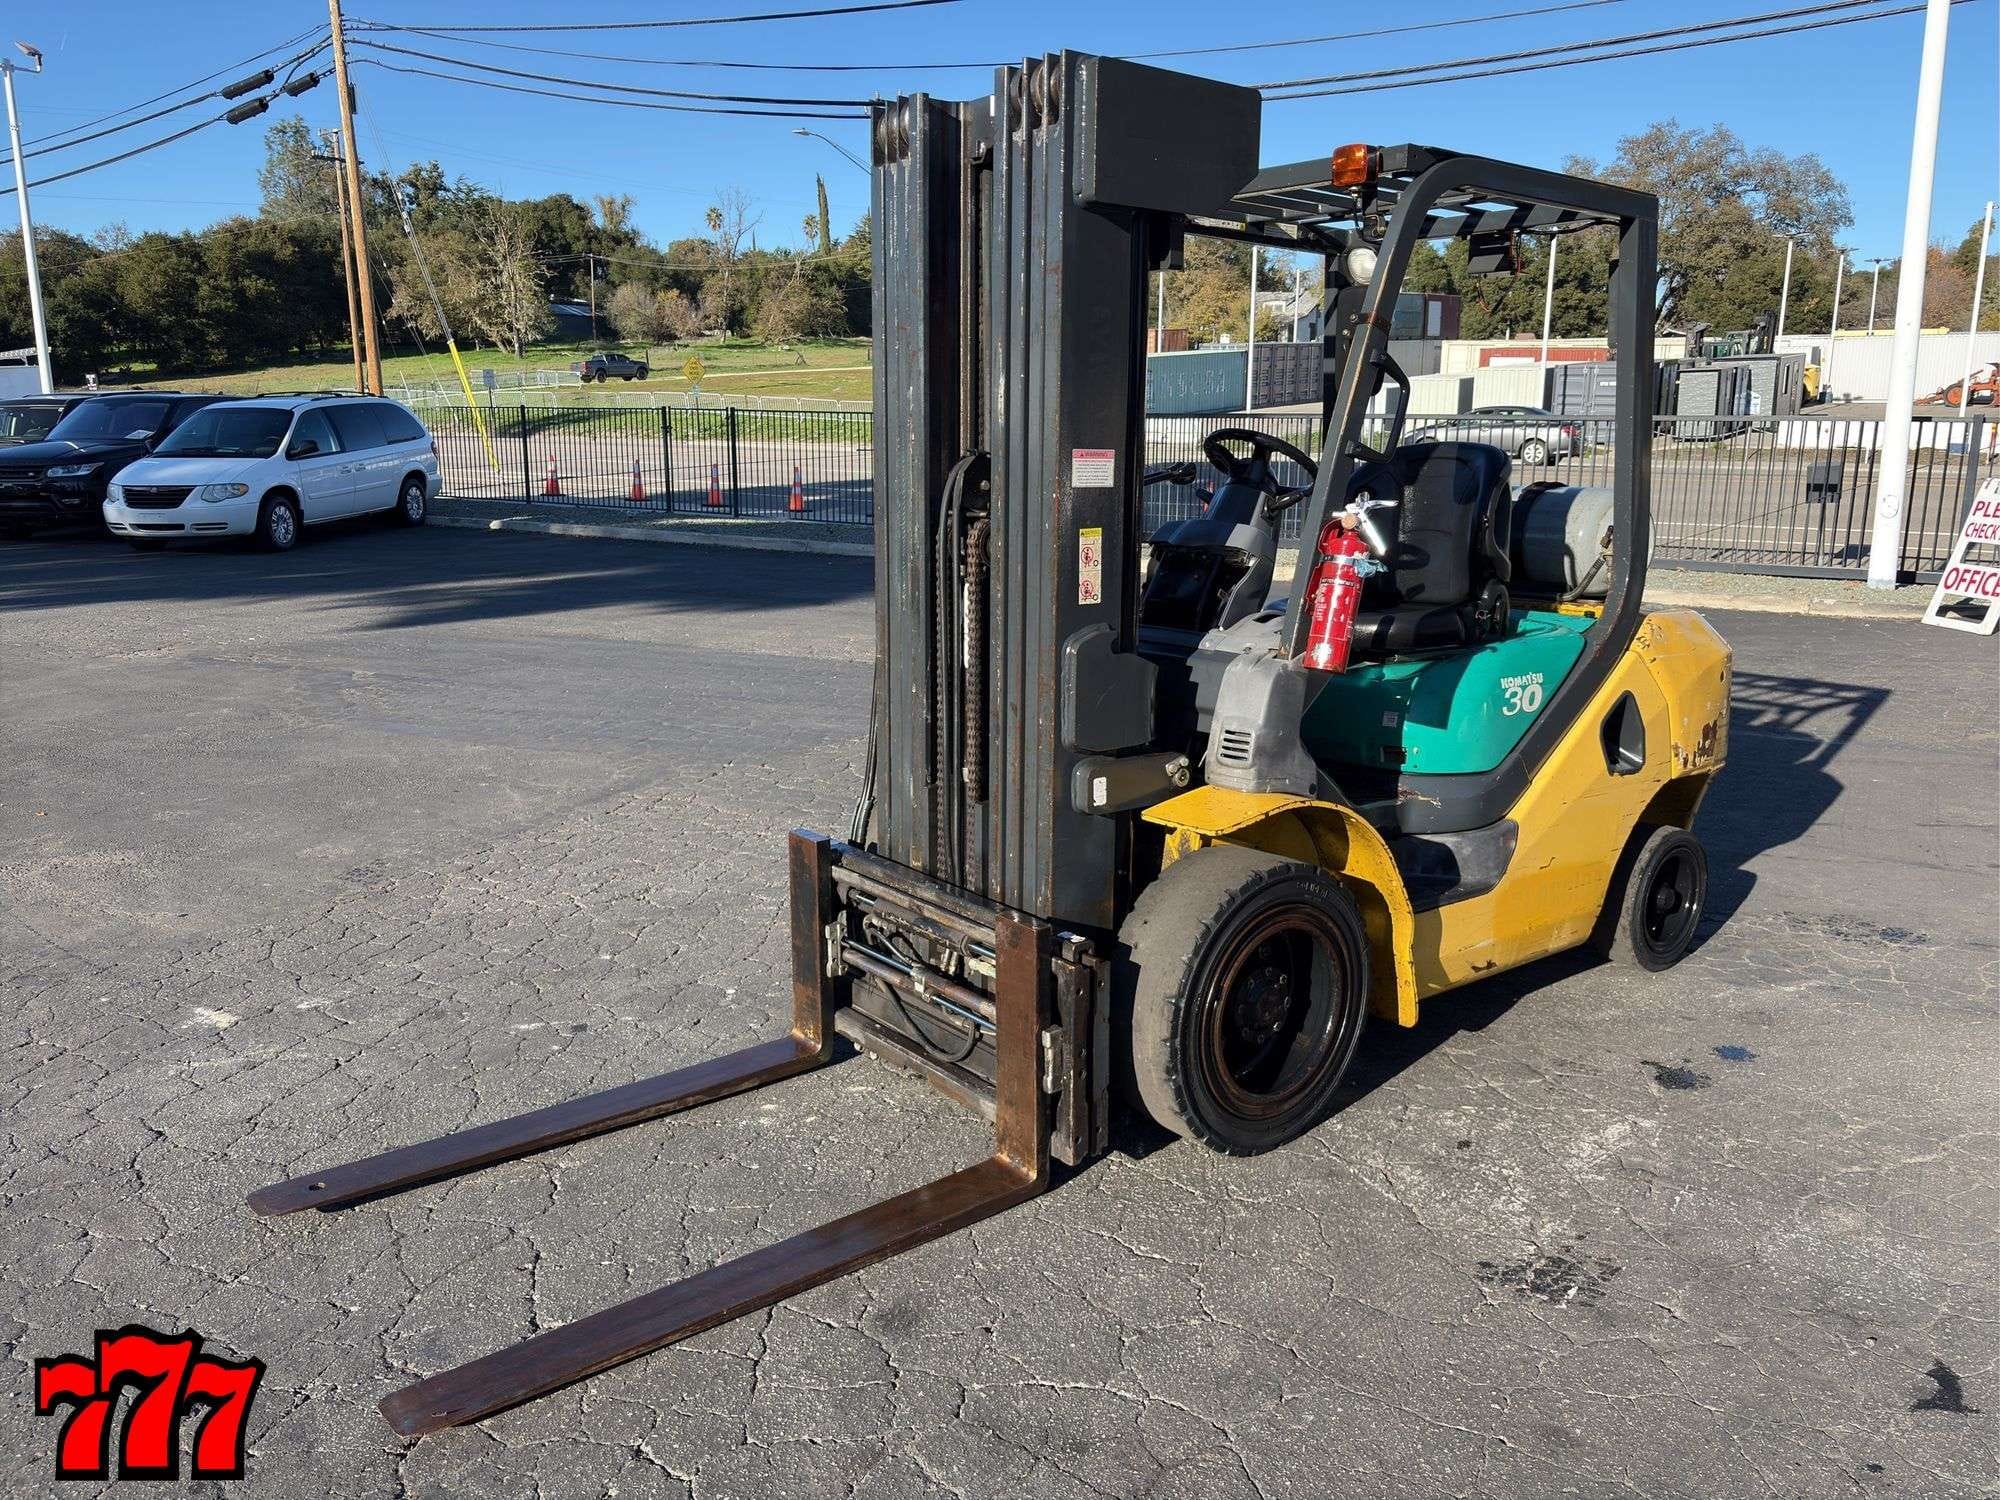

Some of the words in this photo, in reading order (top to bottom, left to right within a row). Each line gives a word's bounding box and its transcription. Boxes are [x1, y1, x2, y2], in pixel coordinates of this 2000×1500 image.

[1965, 522, 2000, 540] CHECK
[1944, 567, 2000, 597] OFFICE
[1500, 672, 1544, 689] KOMATSU
[1502, 684, 1543, 716] 30
